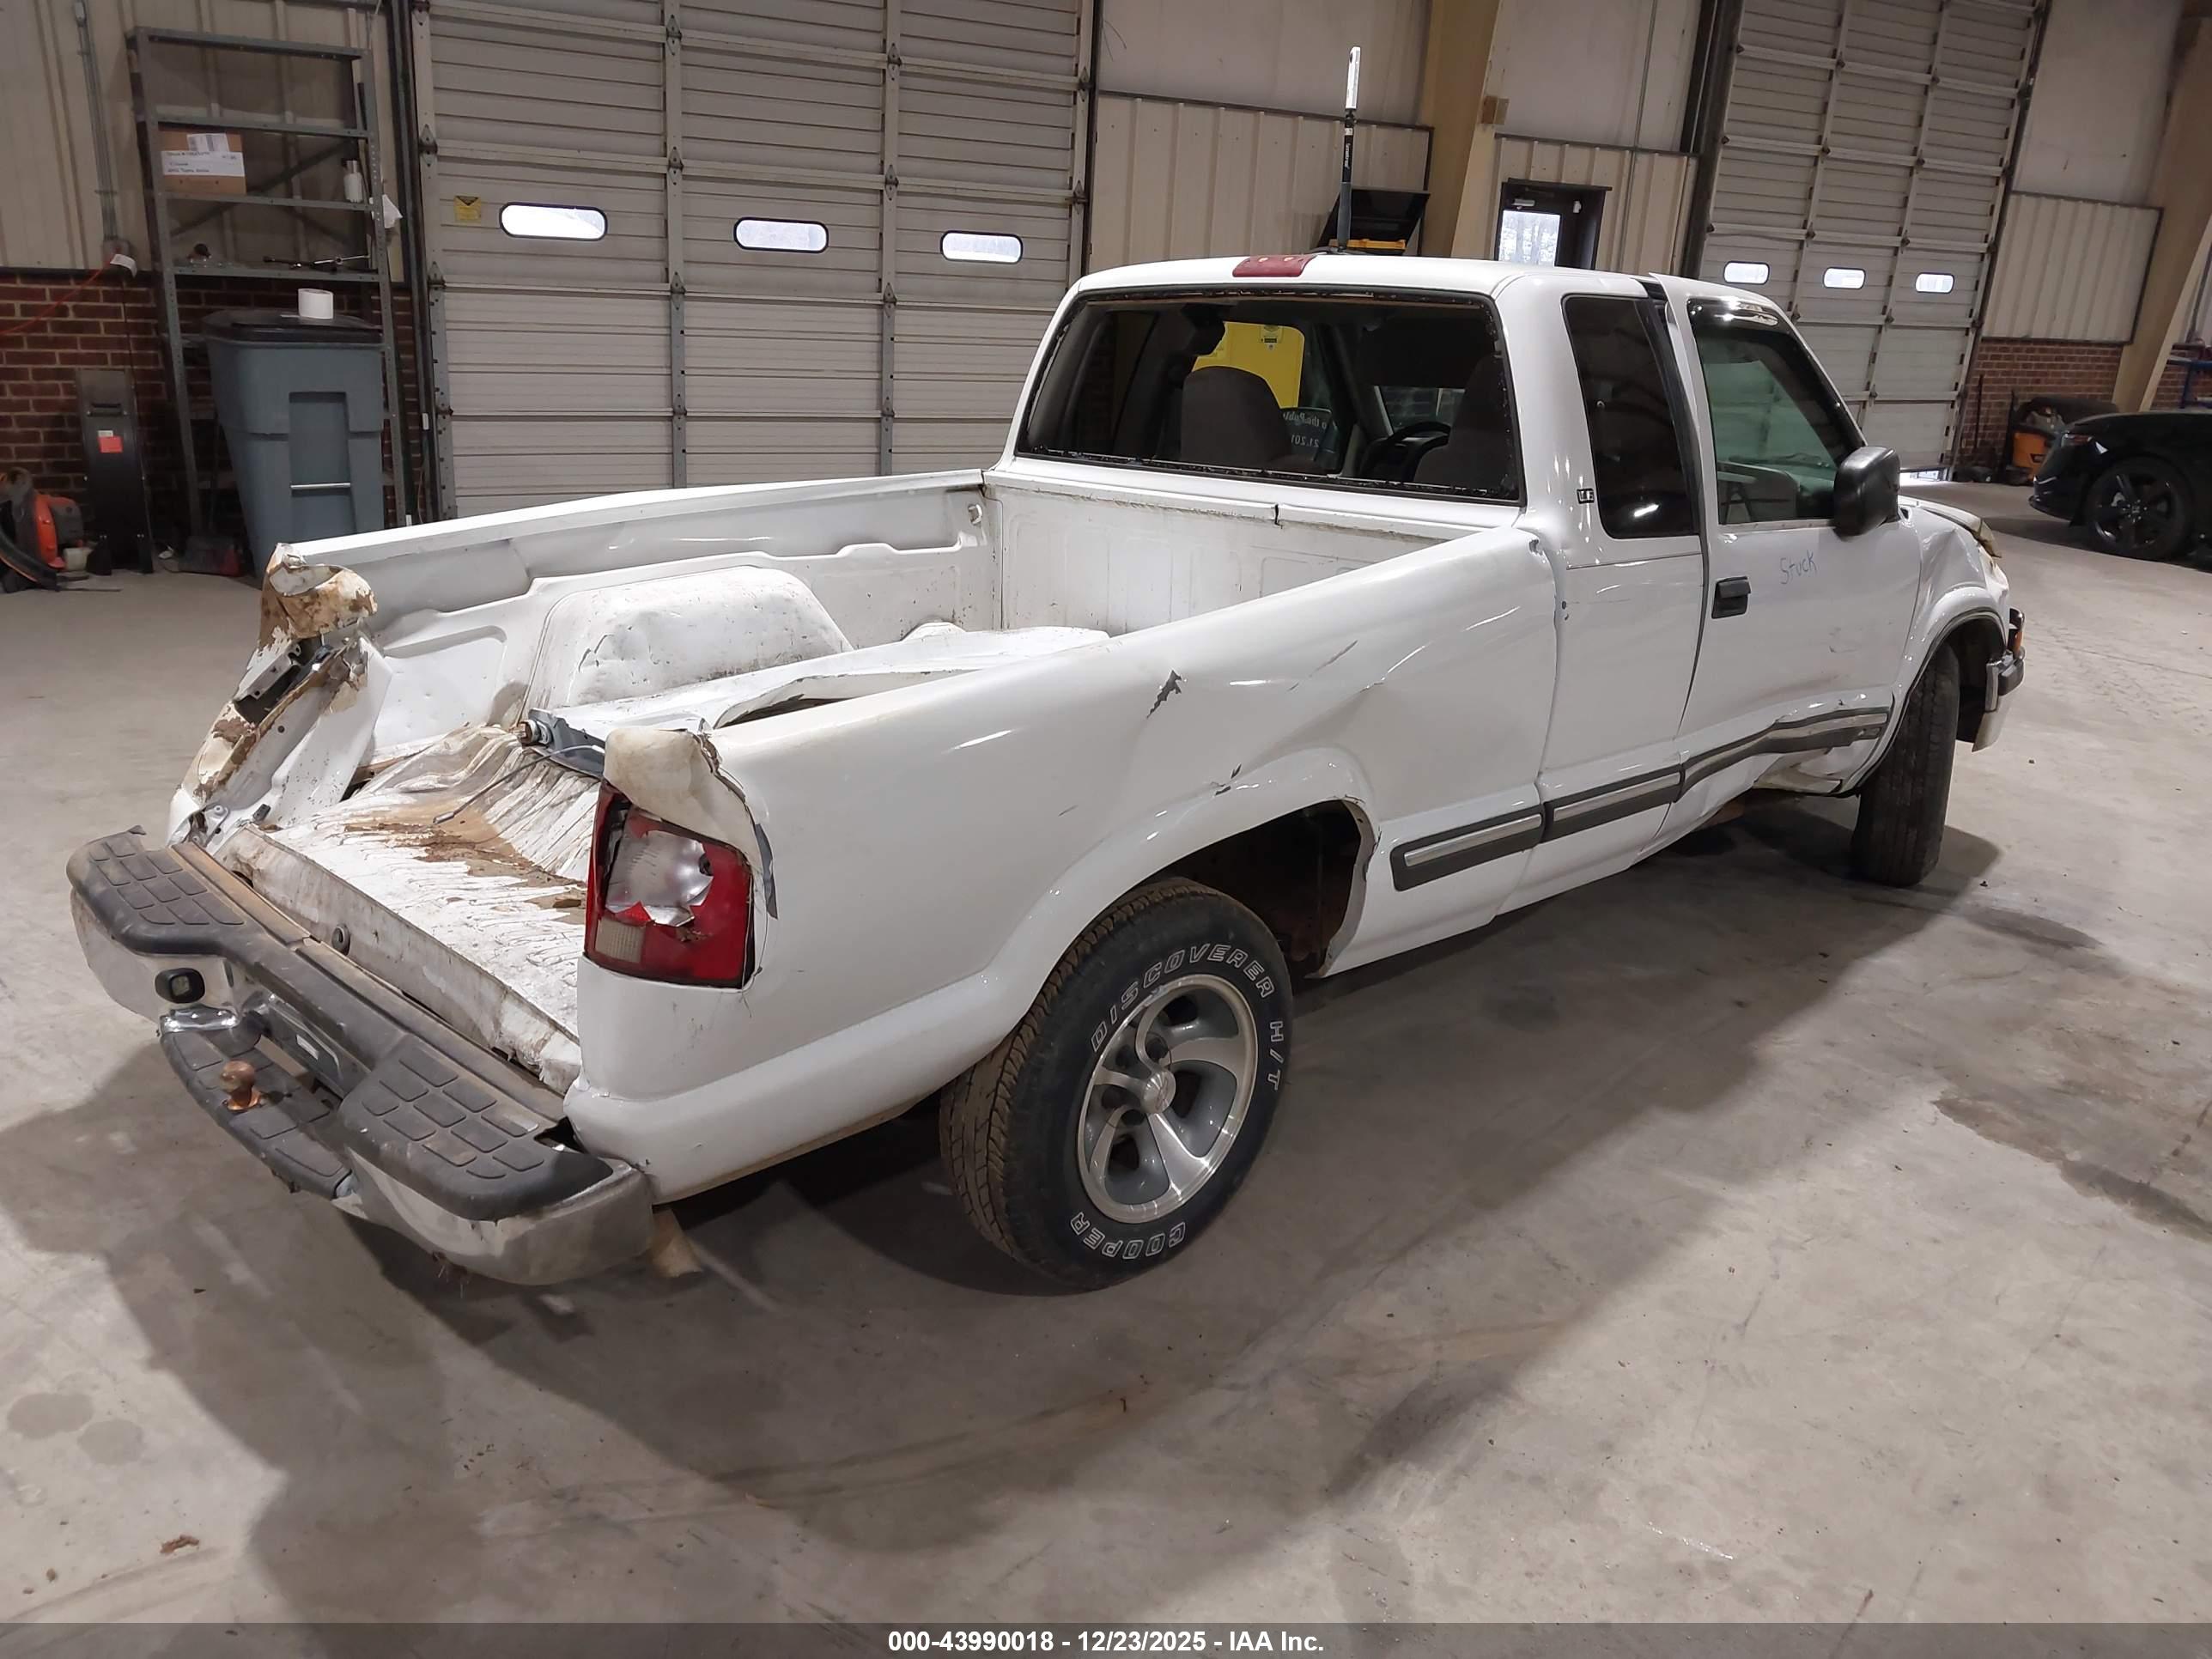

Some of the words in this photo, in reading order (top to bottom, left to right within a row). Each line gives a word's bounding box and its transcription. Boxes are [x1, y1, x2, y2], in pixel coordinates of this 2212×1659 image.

[1091, 942, 1275, 1053] DISCOVERER
[1267, 1020, 1285, 1091] H/T
[1070, 1212, 1186, 1260] COOPER
